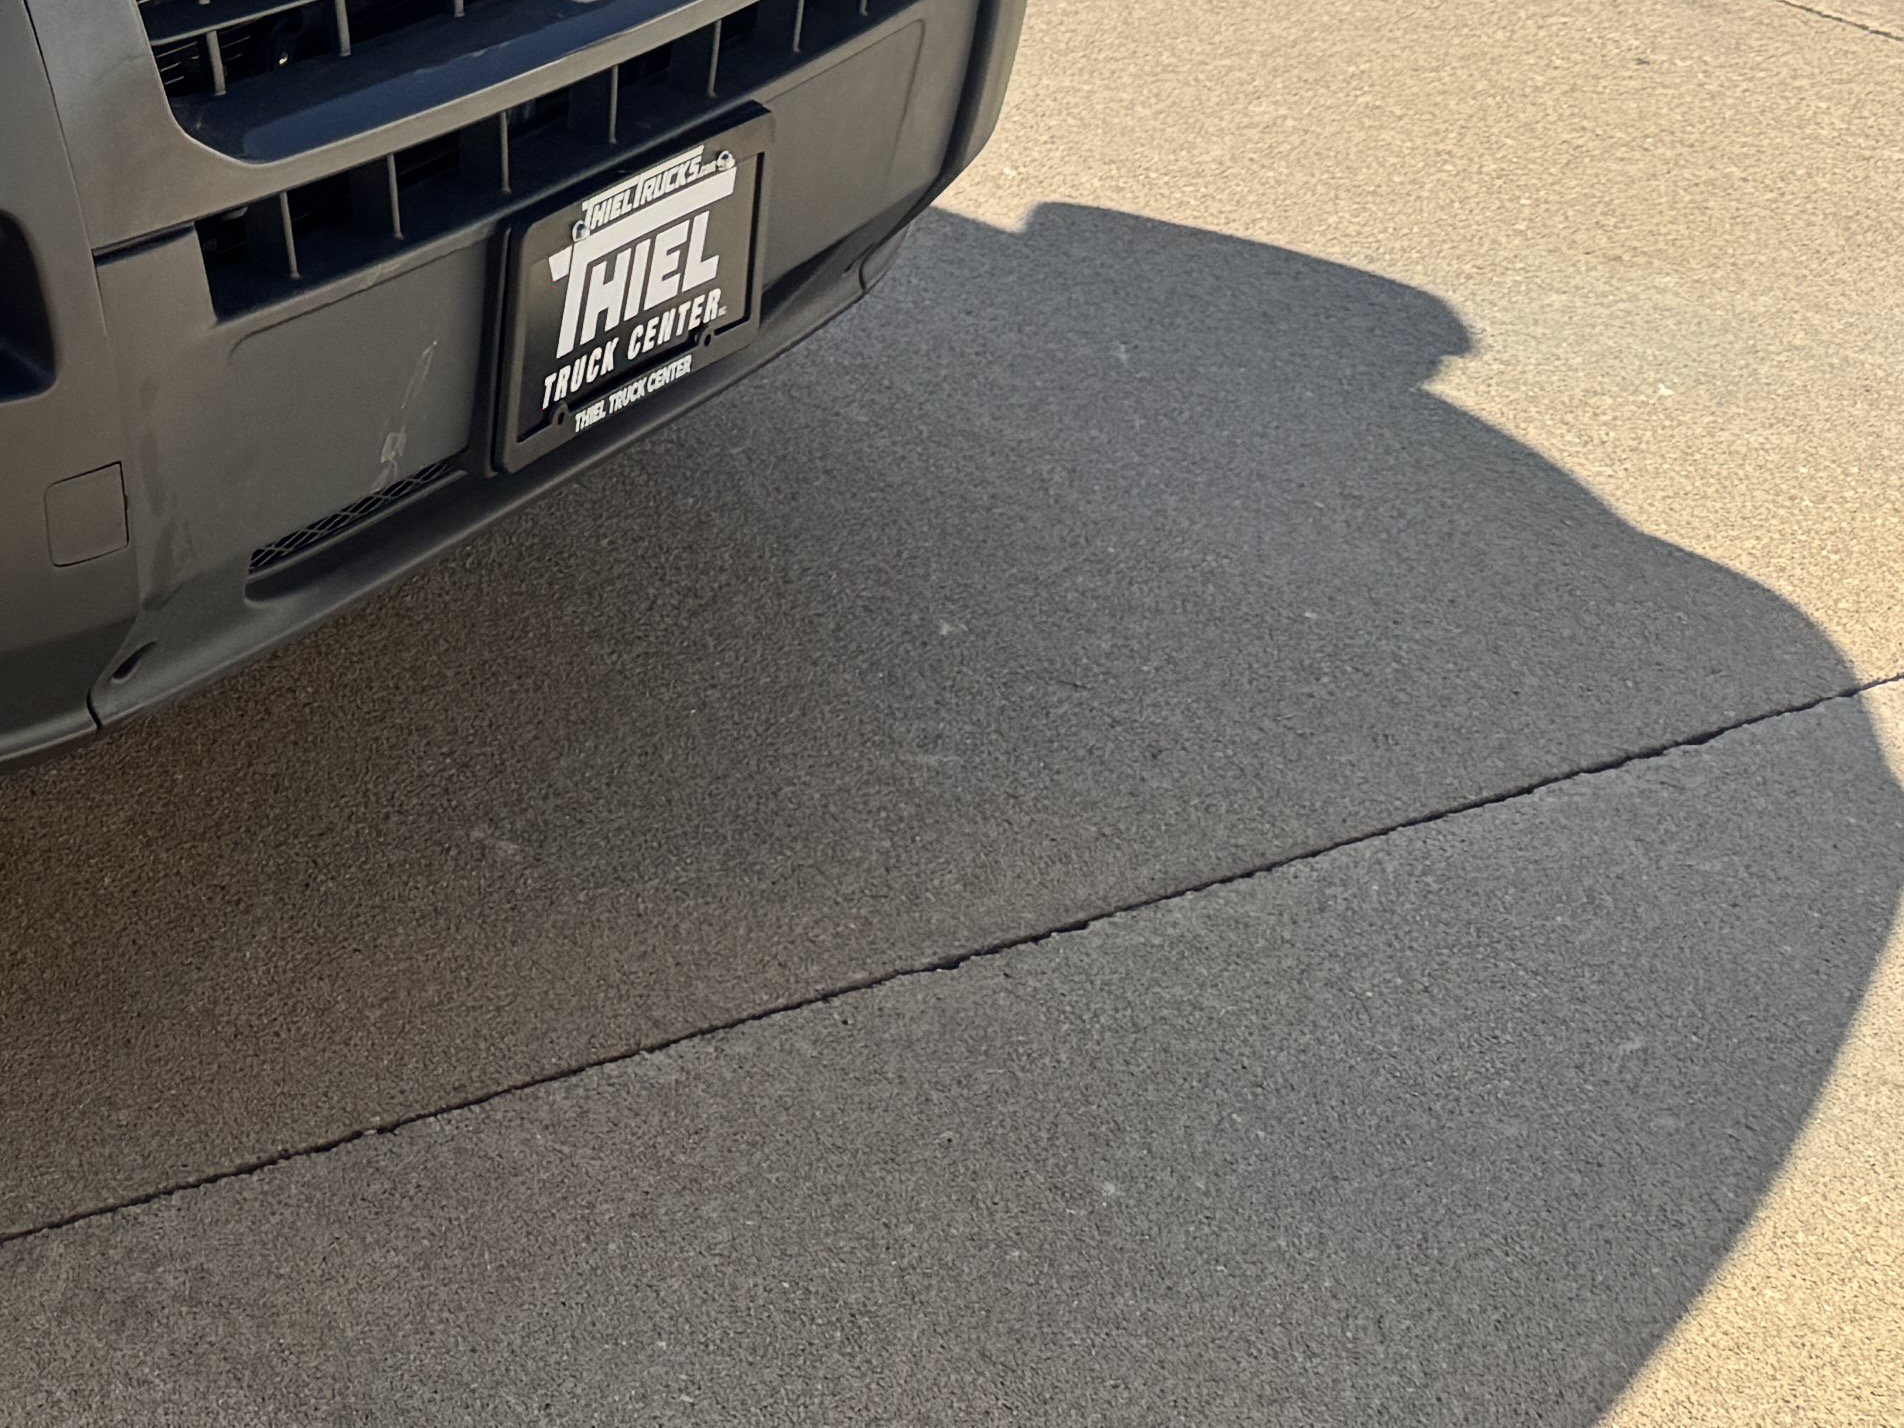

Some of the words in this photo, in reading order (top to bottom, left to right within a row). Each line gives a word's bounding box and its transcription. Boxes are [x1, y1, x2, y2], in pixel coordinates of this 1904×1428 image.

[548, 166, 737, 358] THIEL
[542, 336, 620, 410] TRUCK
[627, 288, 722, 360] CENTER
[574, 399, 607, 433] THIEL
[608, 378, 647, 414] TRUCK
[647, 354, 693, 393] CENTER
